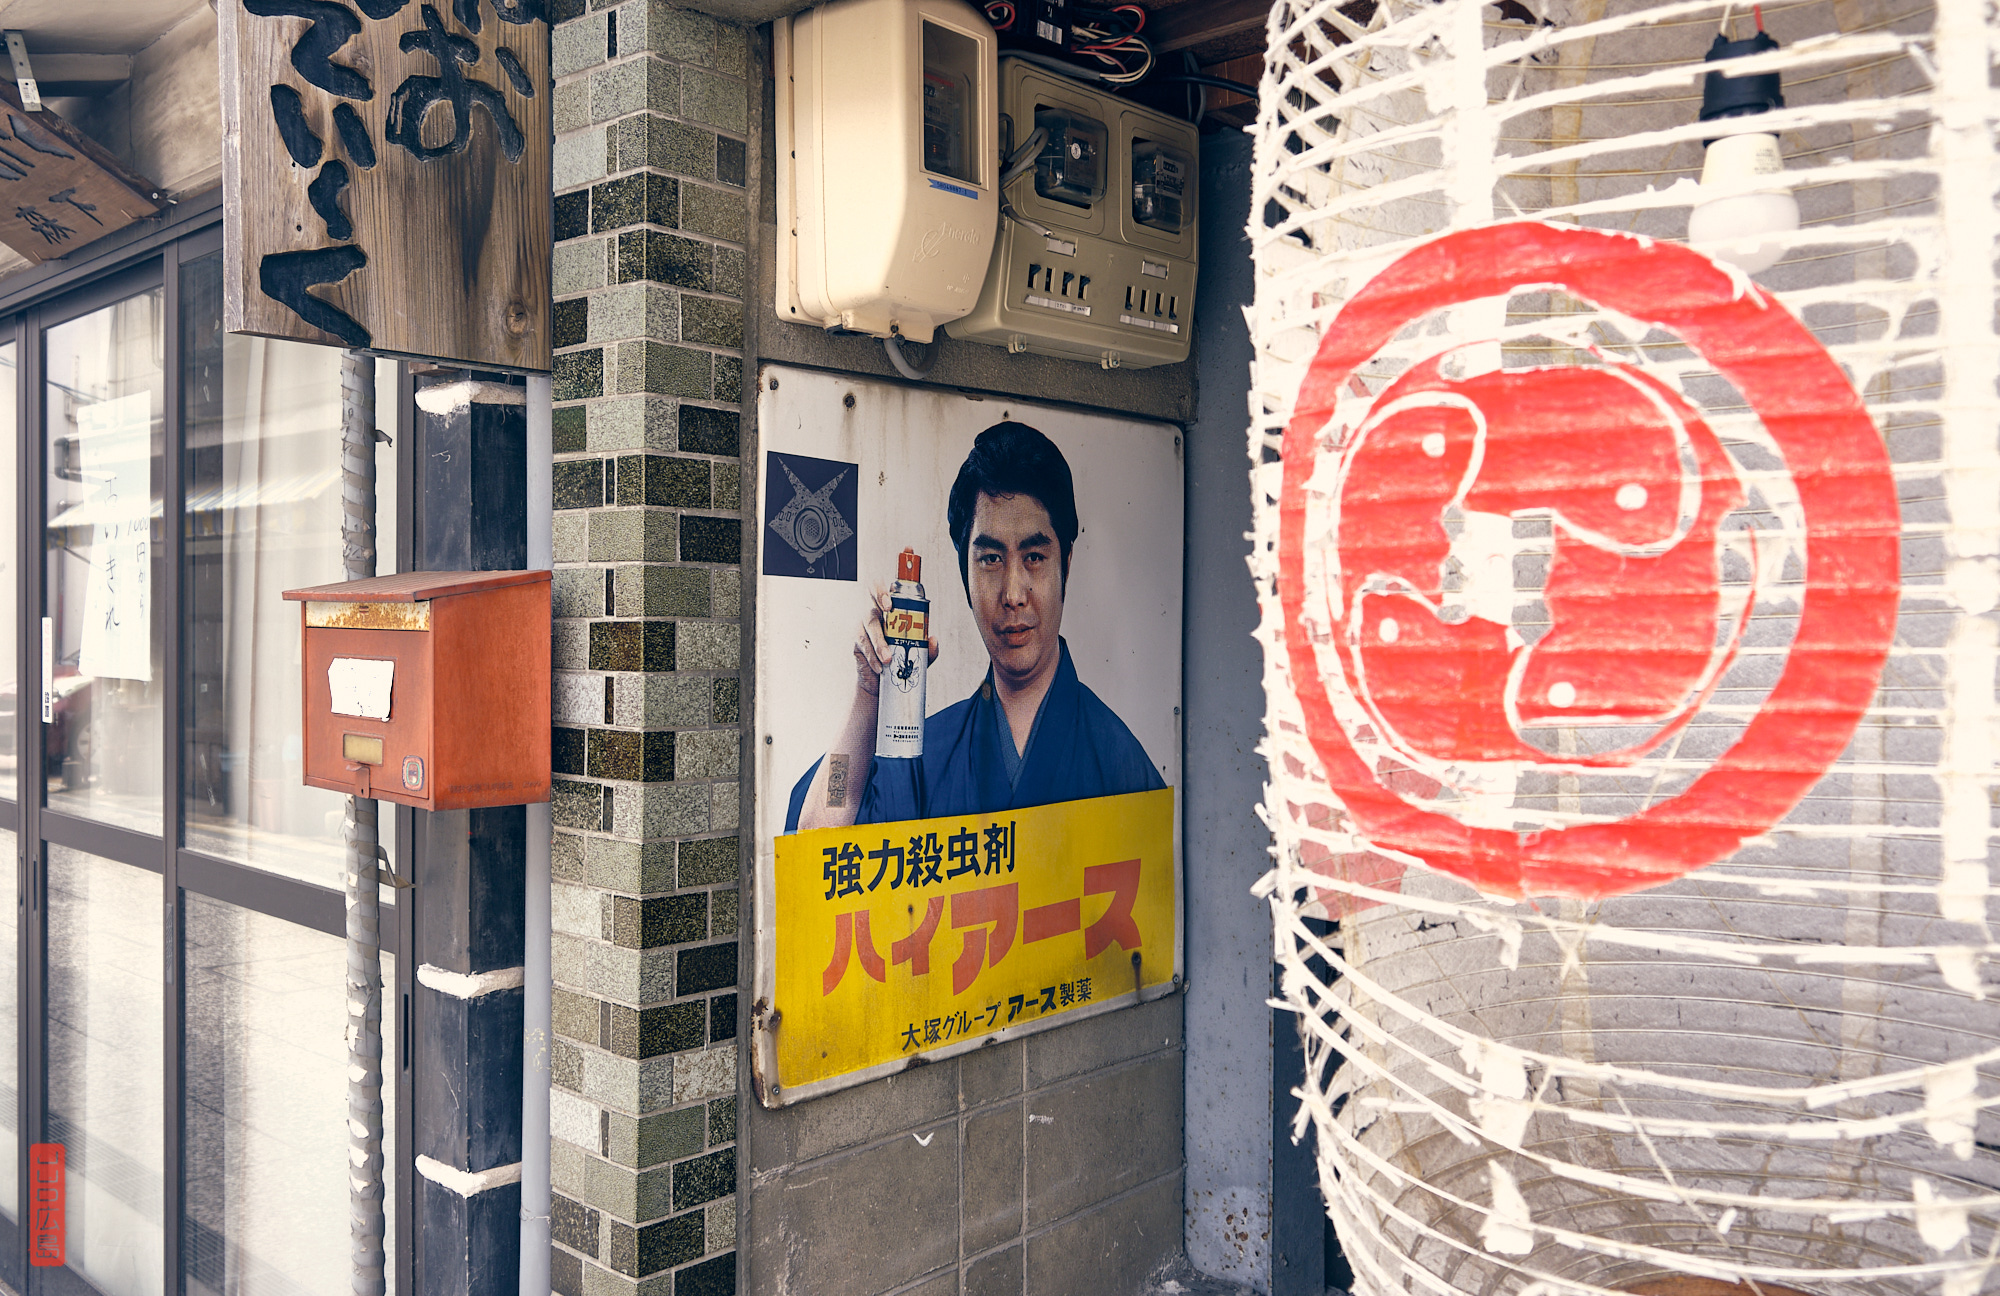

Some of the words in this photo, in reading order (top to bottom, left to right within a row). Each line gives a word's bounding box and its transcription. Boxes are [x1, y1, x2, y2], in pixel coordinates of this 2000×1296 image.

[822, 820, 1017, 900] 強力殺虫剤
[822, 858, 1143, 997] ハイアース
[901, 1001, 1002, 1052] 大塚グループ
[1007, 977, 1092, 1023] アース製薬
